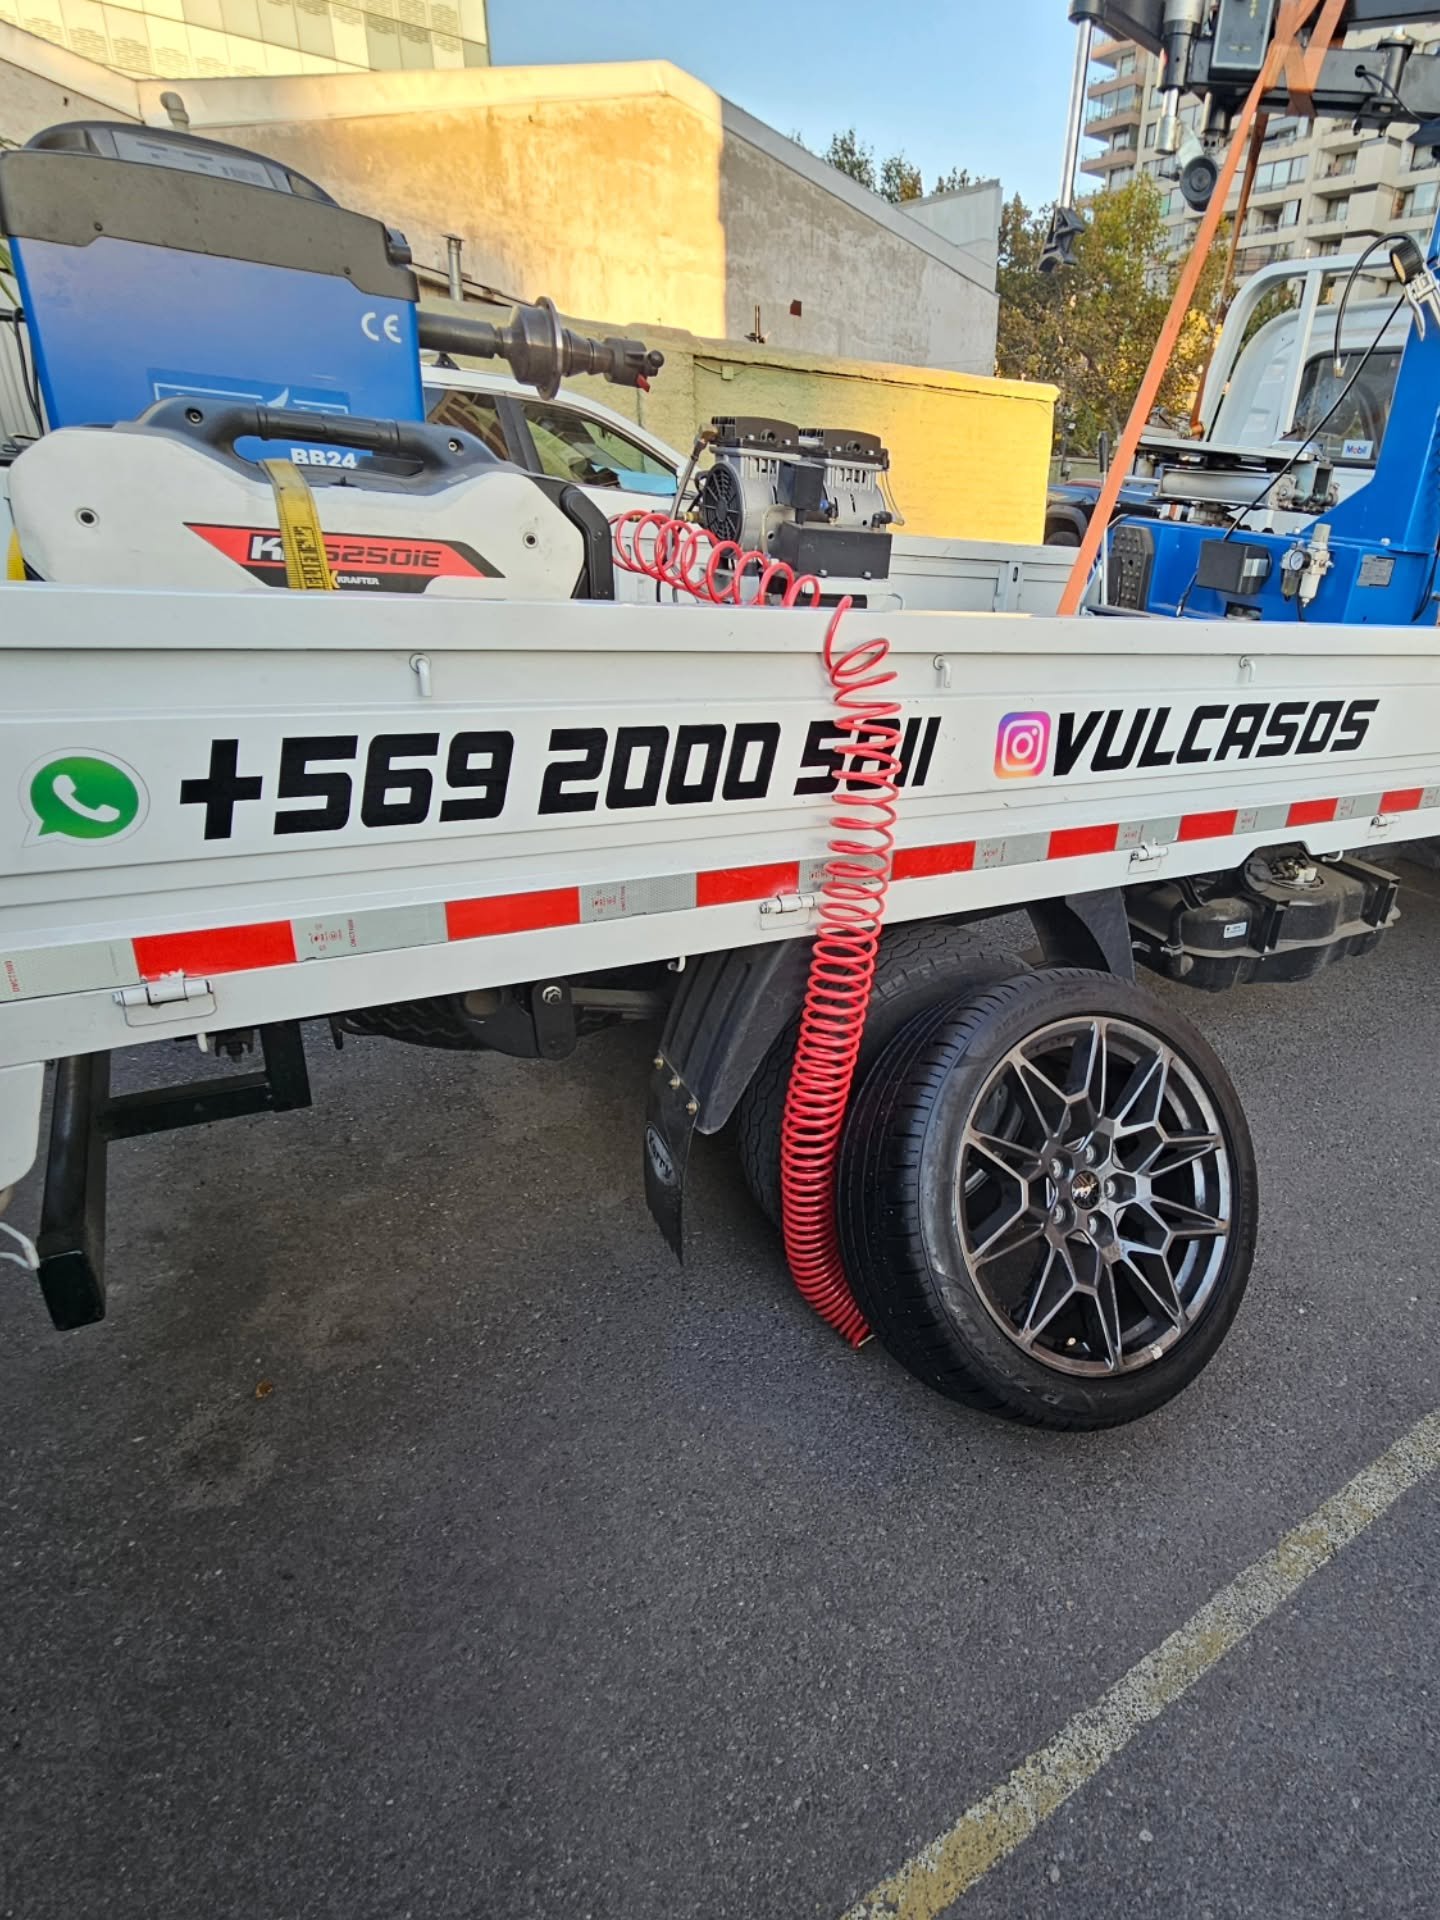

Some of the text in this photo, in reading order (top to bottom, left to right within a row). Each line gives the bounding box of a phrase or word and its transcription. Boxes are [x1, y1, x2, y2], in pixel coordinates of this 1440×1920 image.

[290, 448, 358, 469] BB24
[336, 576, 380, 585] KRAFTER
[1053, 698, 1380, 777] VULCASOS
[180, 730, 514, 840] +569
[537, 722, 781, 815] 2000
